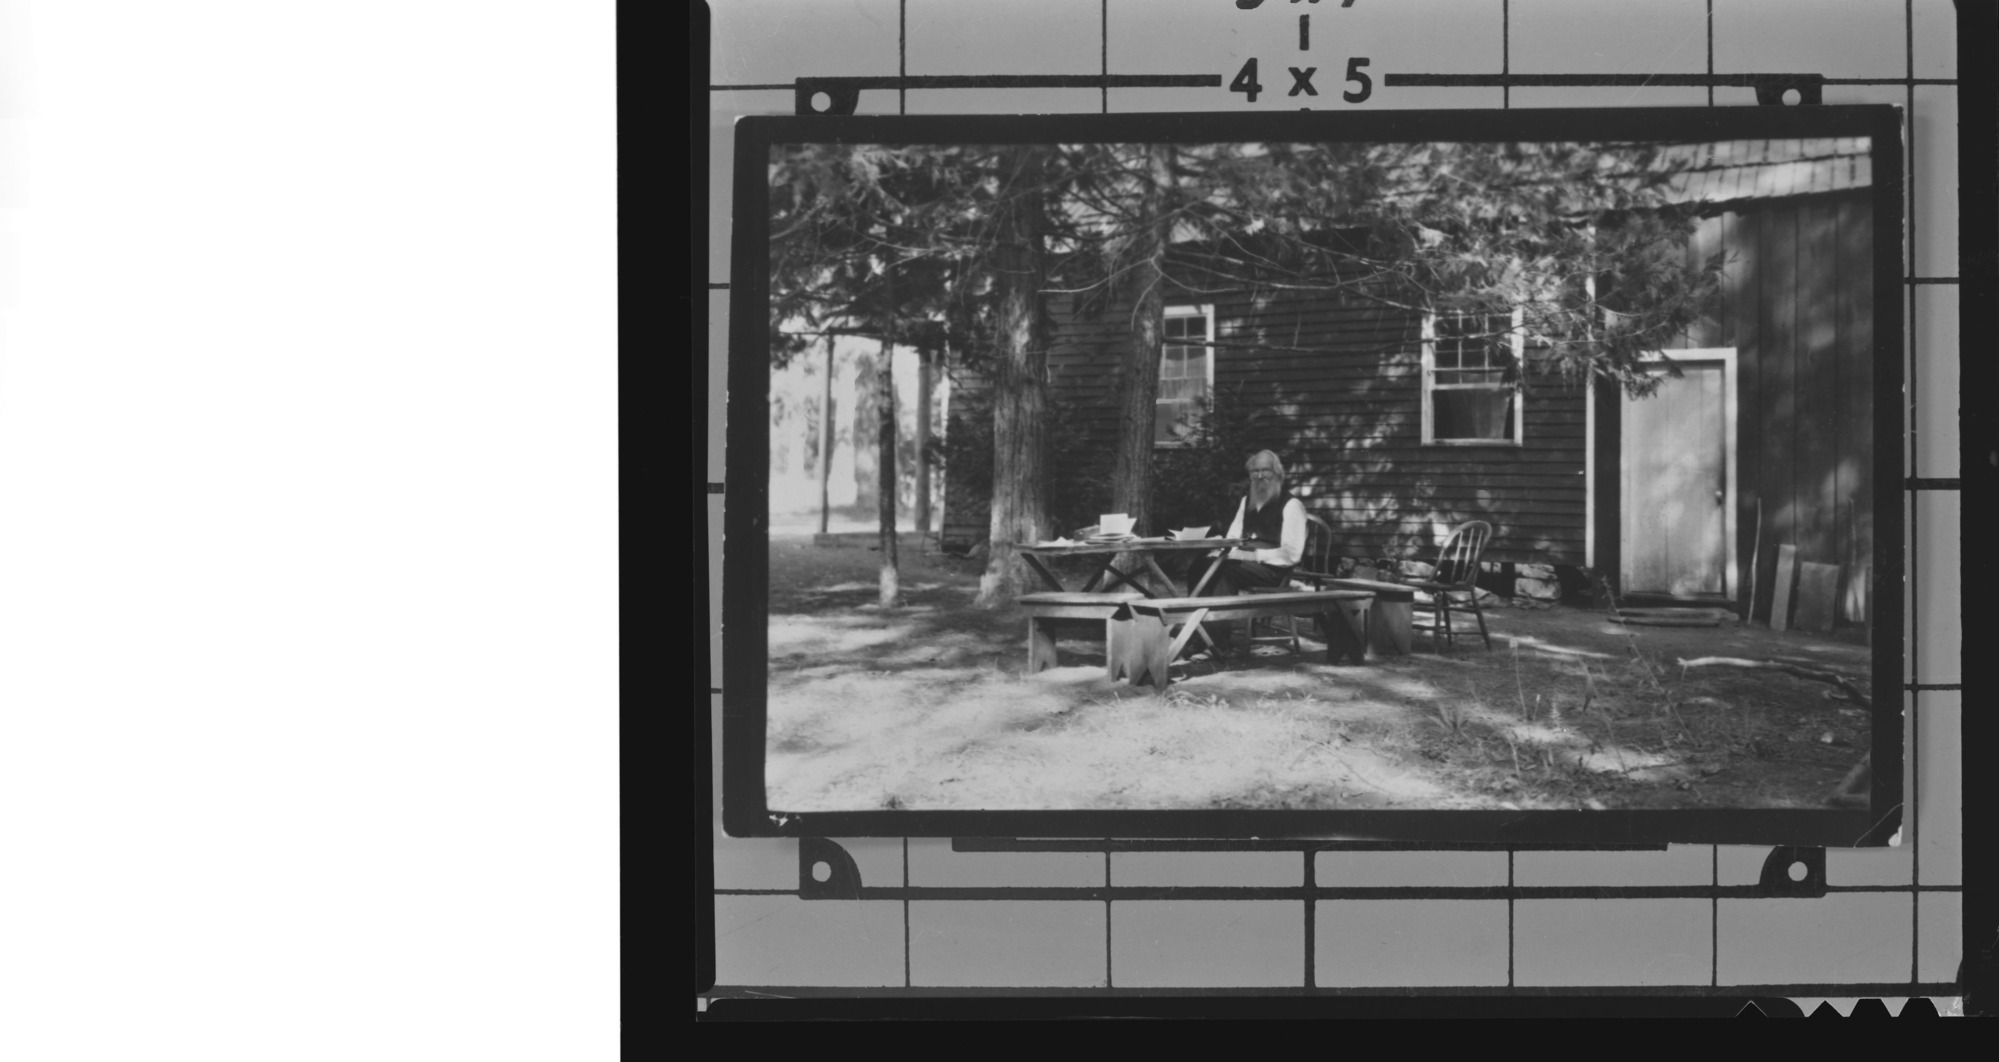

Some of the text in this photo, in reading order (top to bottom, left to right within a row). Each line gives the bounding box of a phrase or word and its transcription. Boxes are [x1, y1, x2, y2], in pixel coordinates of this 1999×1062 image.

[1229, 57, 1373, 104] 4 x 5
